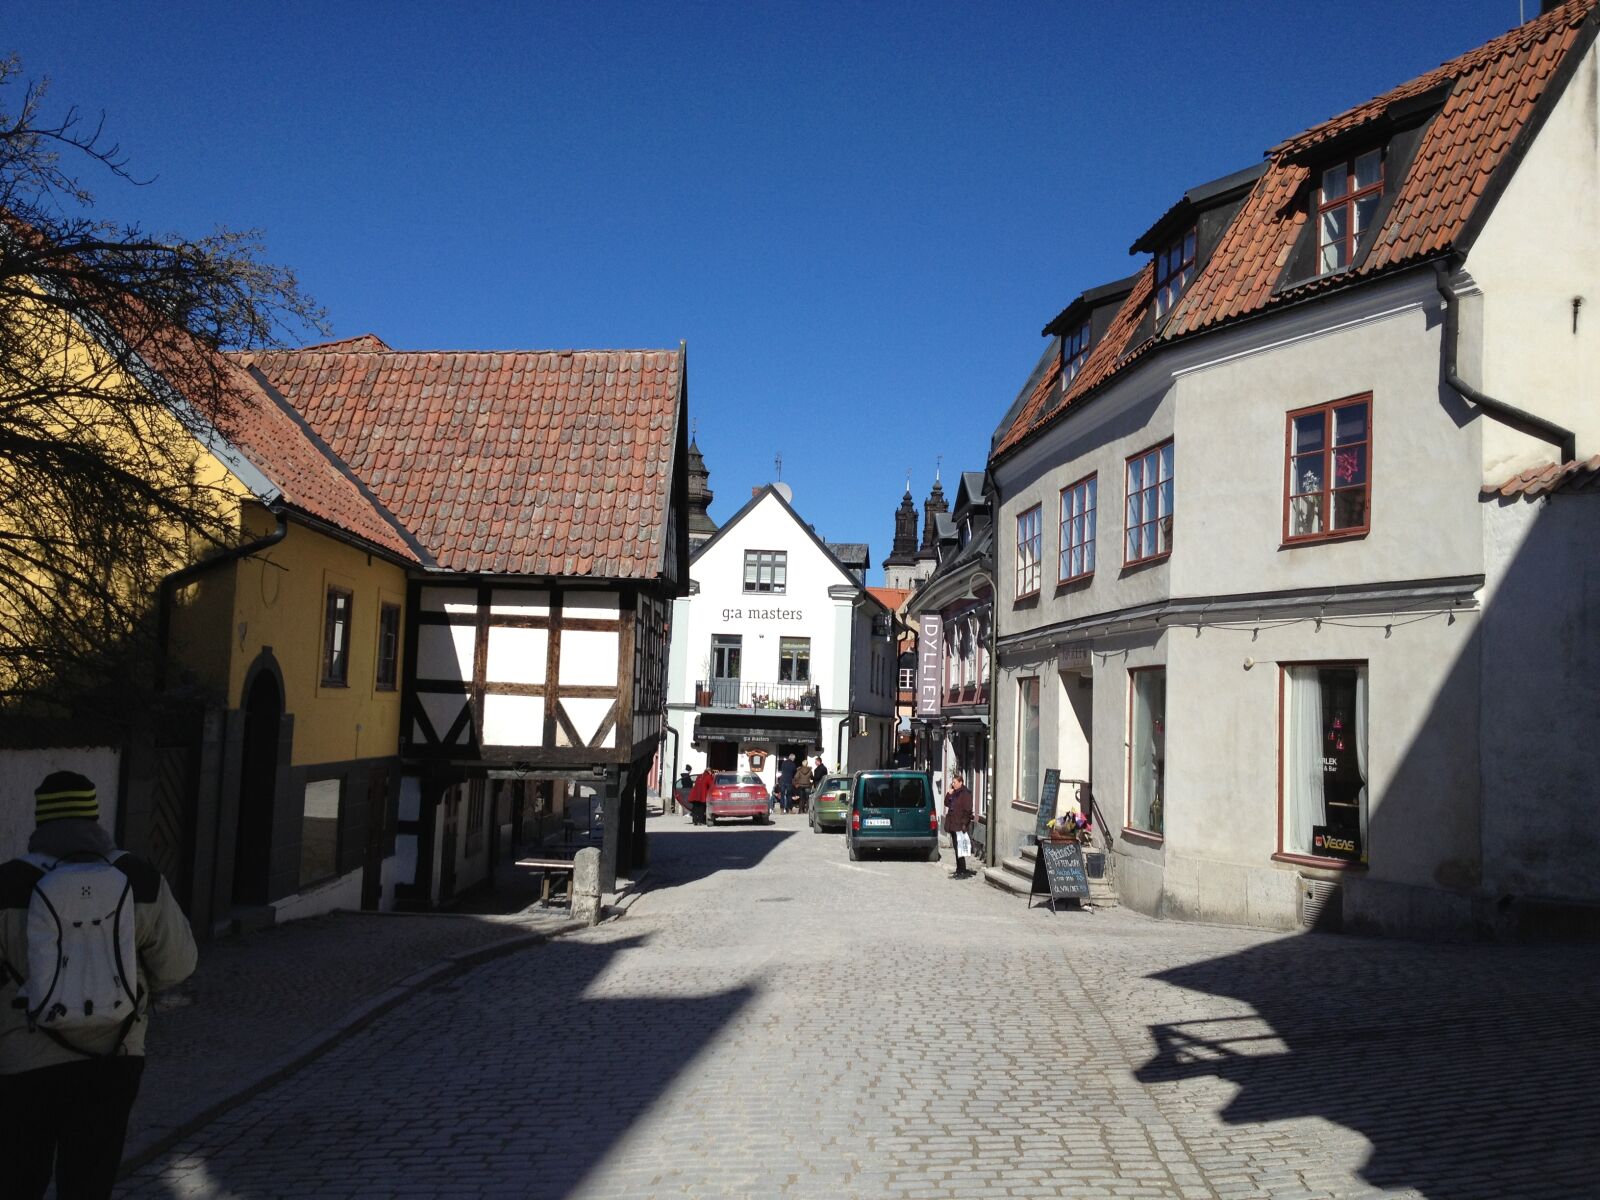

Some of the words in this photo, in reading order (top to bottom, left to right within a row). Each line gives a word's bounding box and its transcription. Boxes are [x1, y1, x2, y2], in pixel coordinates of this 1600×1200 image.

[748, 607, 802, 620] masters
[922, 616, 938, 711] IDYLLIEN
[1321, 834, 1355, 850] VEGAS
